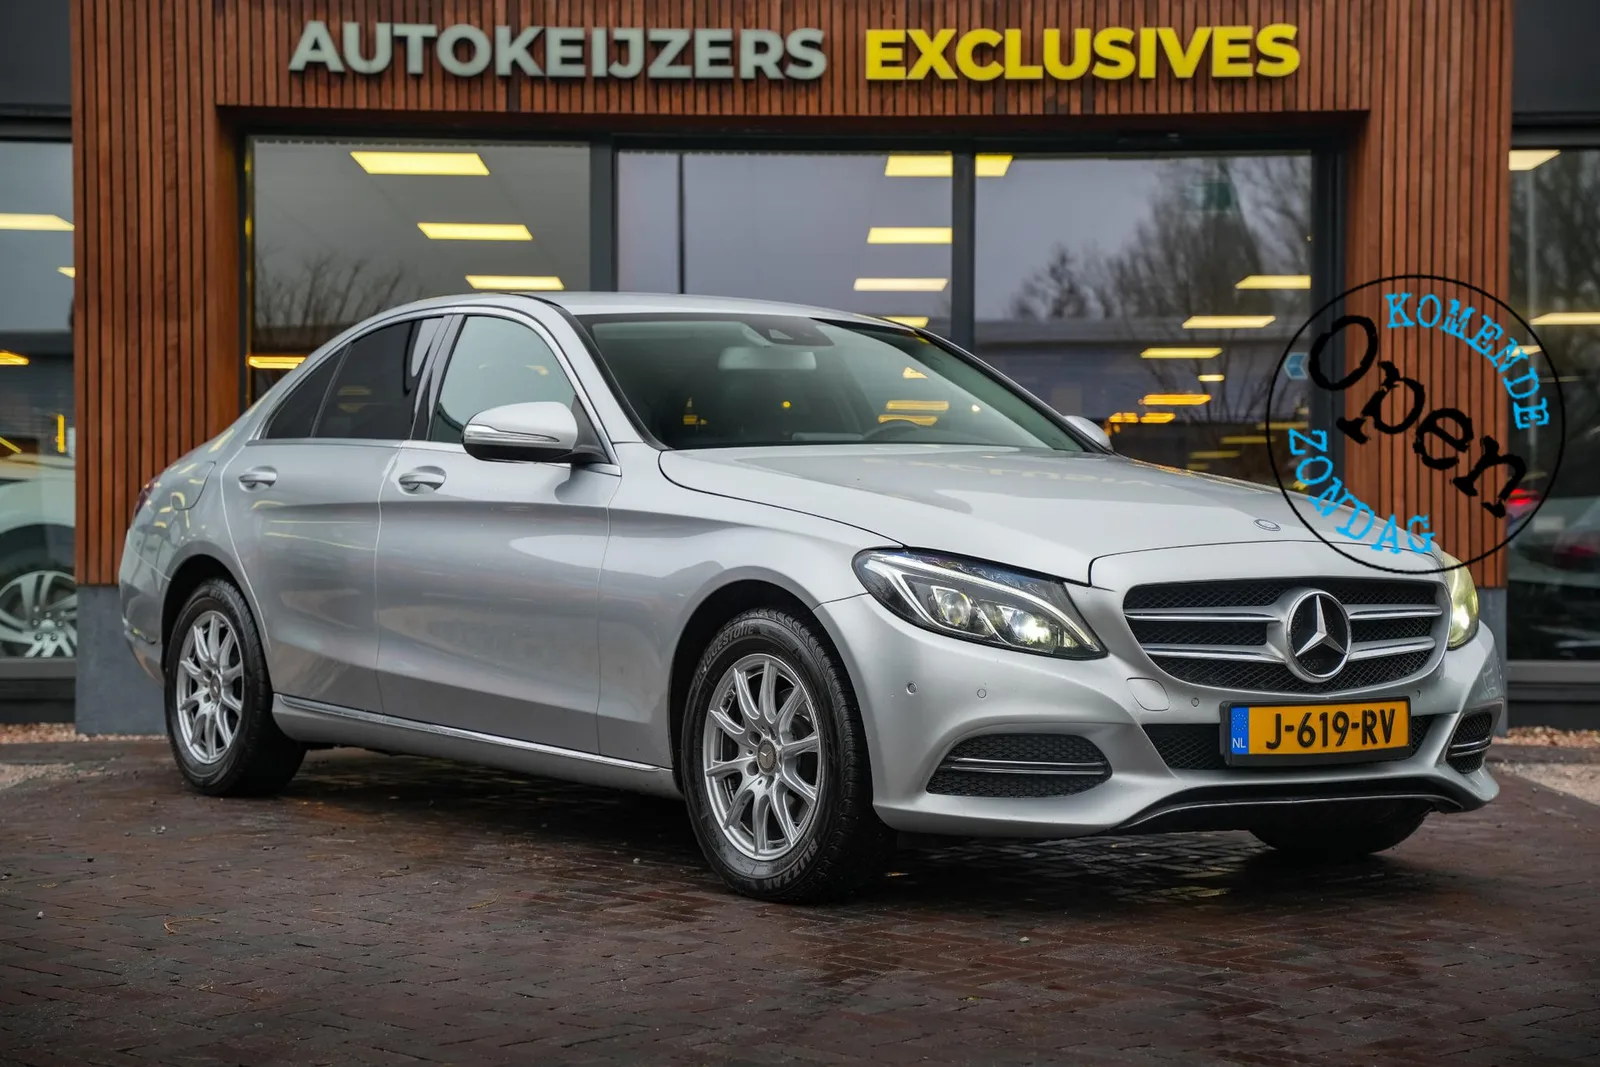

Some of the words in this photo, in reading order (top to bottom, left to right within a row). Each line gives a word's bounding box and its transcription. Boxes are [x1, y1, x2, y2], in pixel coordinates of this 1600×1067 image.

[288, 21, 826, 79] AUTOKEIJZERS
[865, 23, 1300, 81] EXCLUSIVES
[1232, 737, 1246, 748] NL
[1266, 709, 1395, 749] J-619-RV
